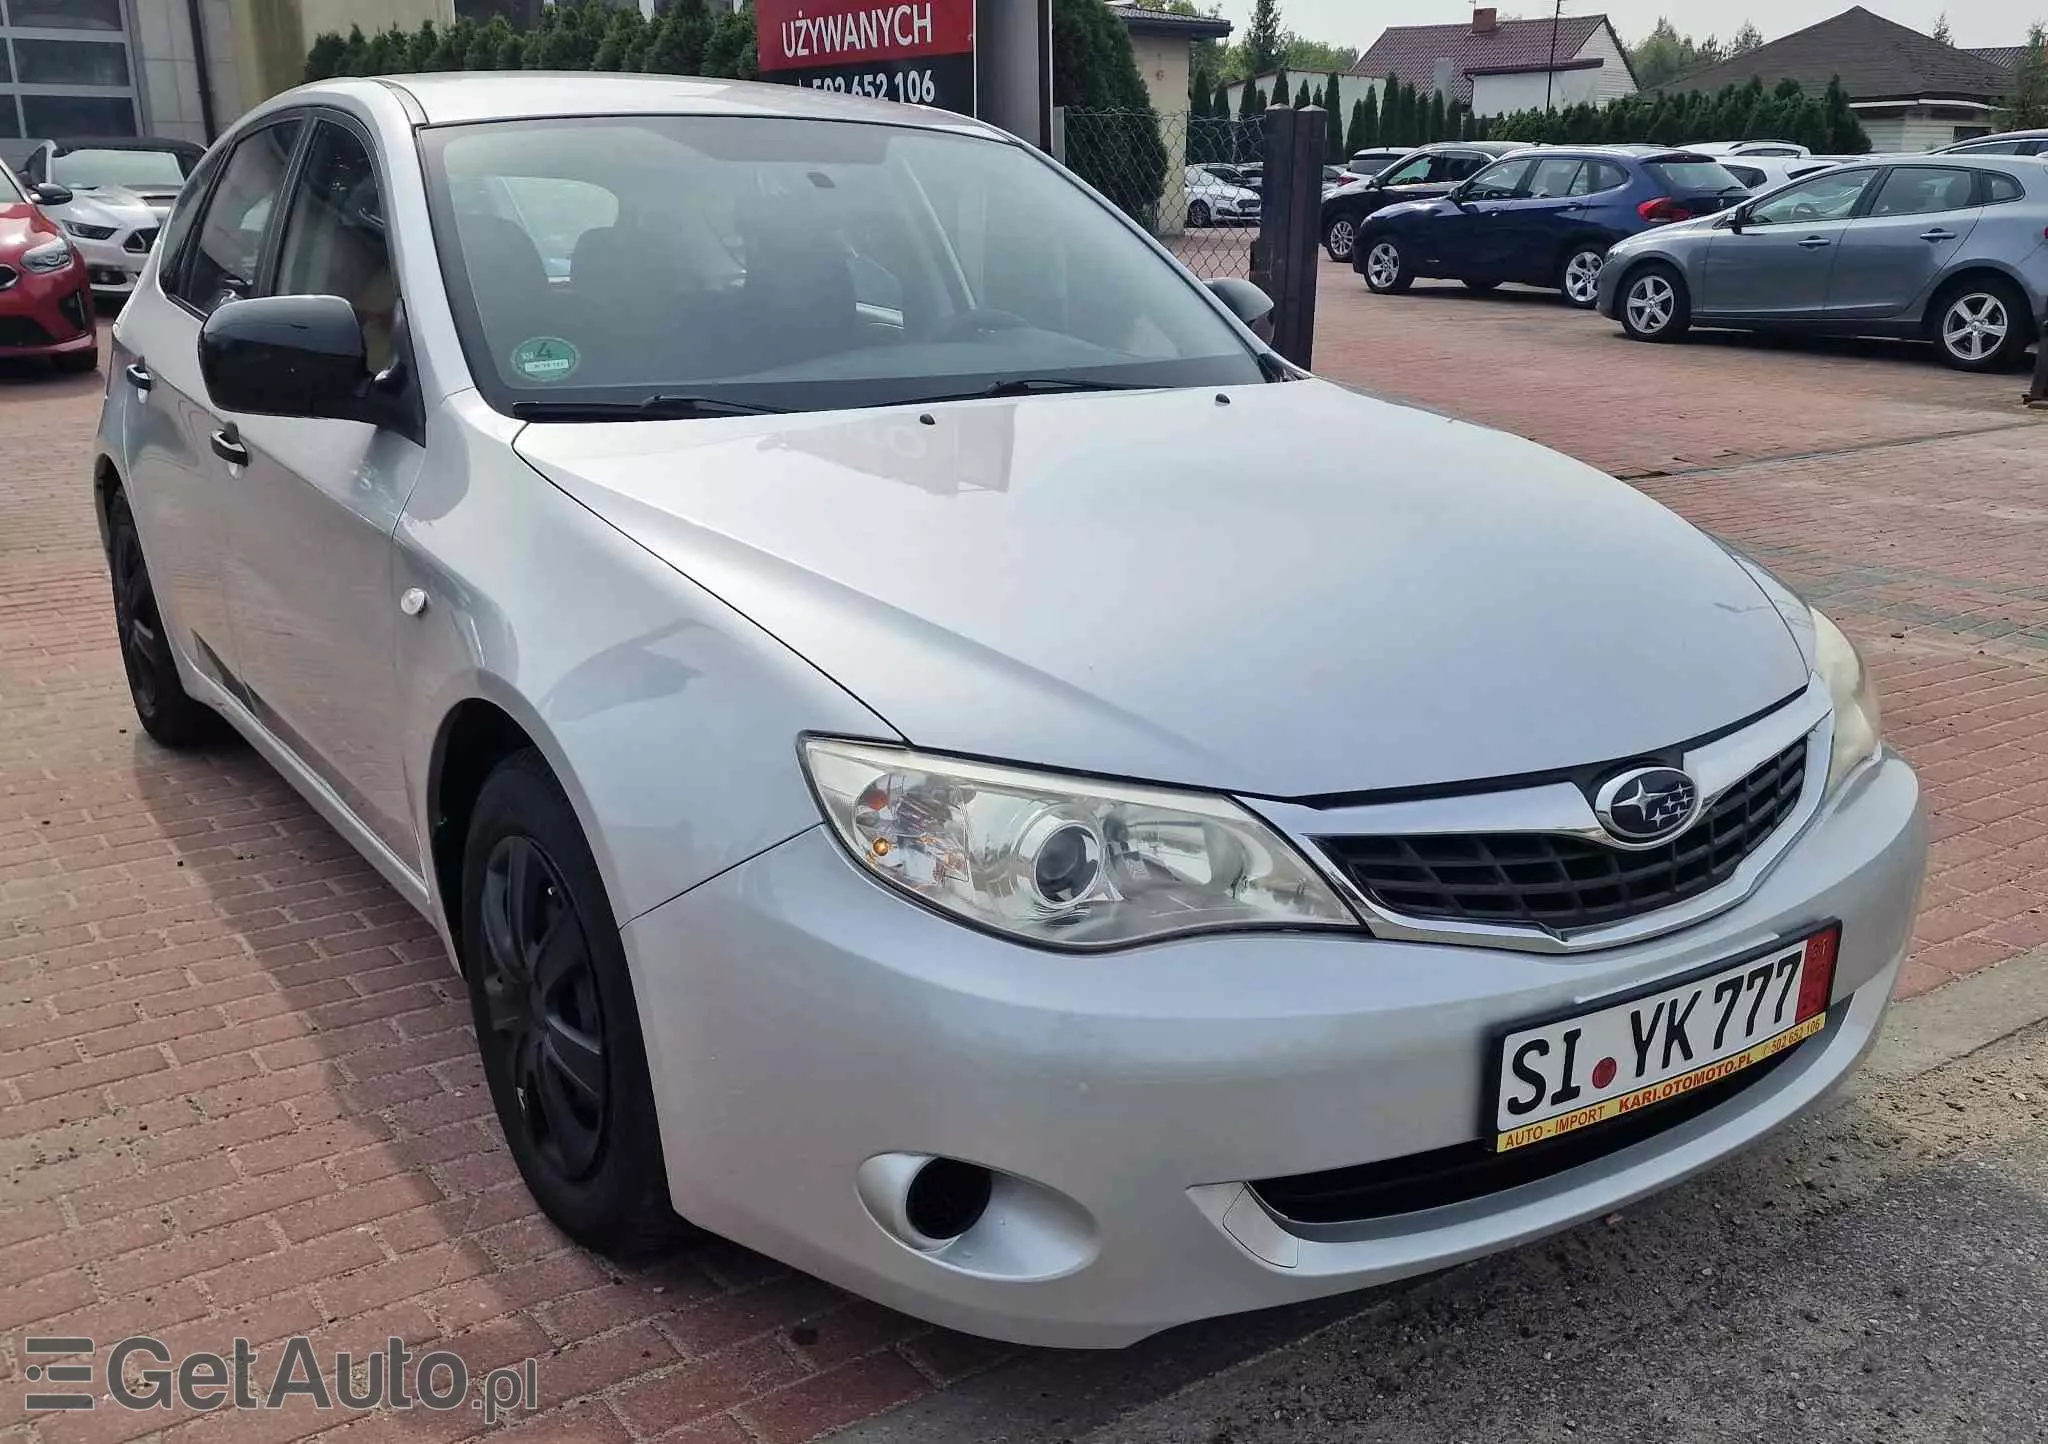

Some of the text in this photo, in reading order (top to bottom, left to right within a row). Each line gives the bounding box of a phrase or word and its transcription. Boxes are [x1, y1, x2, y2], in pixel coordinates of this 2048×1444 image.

[782, 3, 932, 58] UŻYWANYCH
[894, 69, 936, 104] 106
[1507, 950, 1803, 1115] SI YK 777
[1505, 1126, 1543, 1148] AUTO
[1555, 1105, 1606, 1134] IMPORT
[1618, 1054, 1754, 1113] KARI.OTOMOTO.PL
